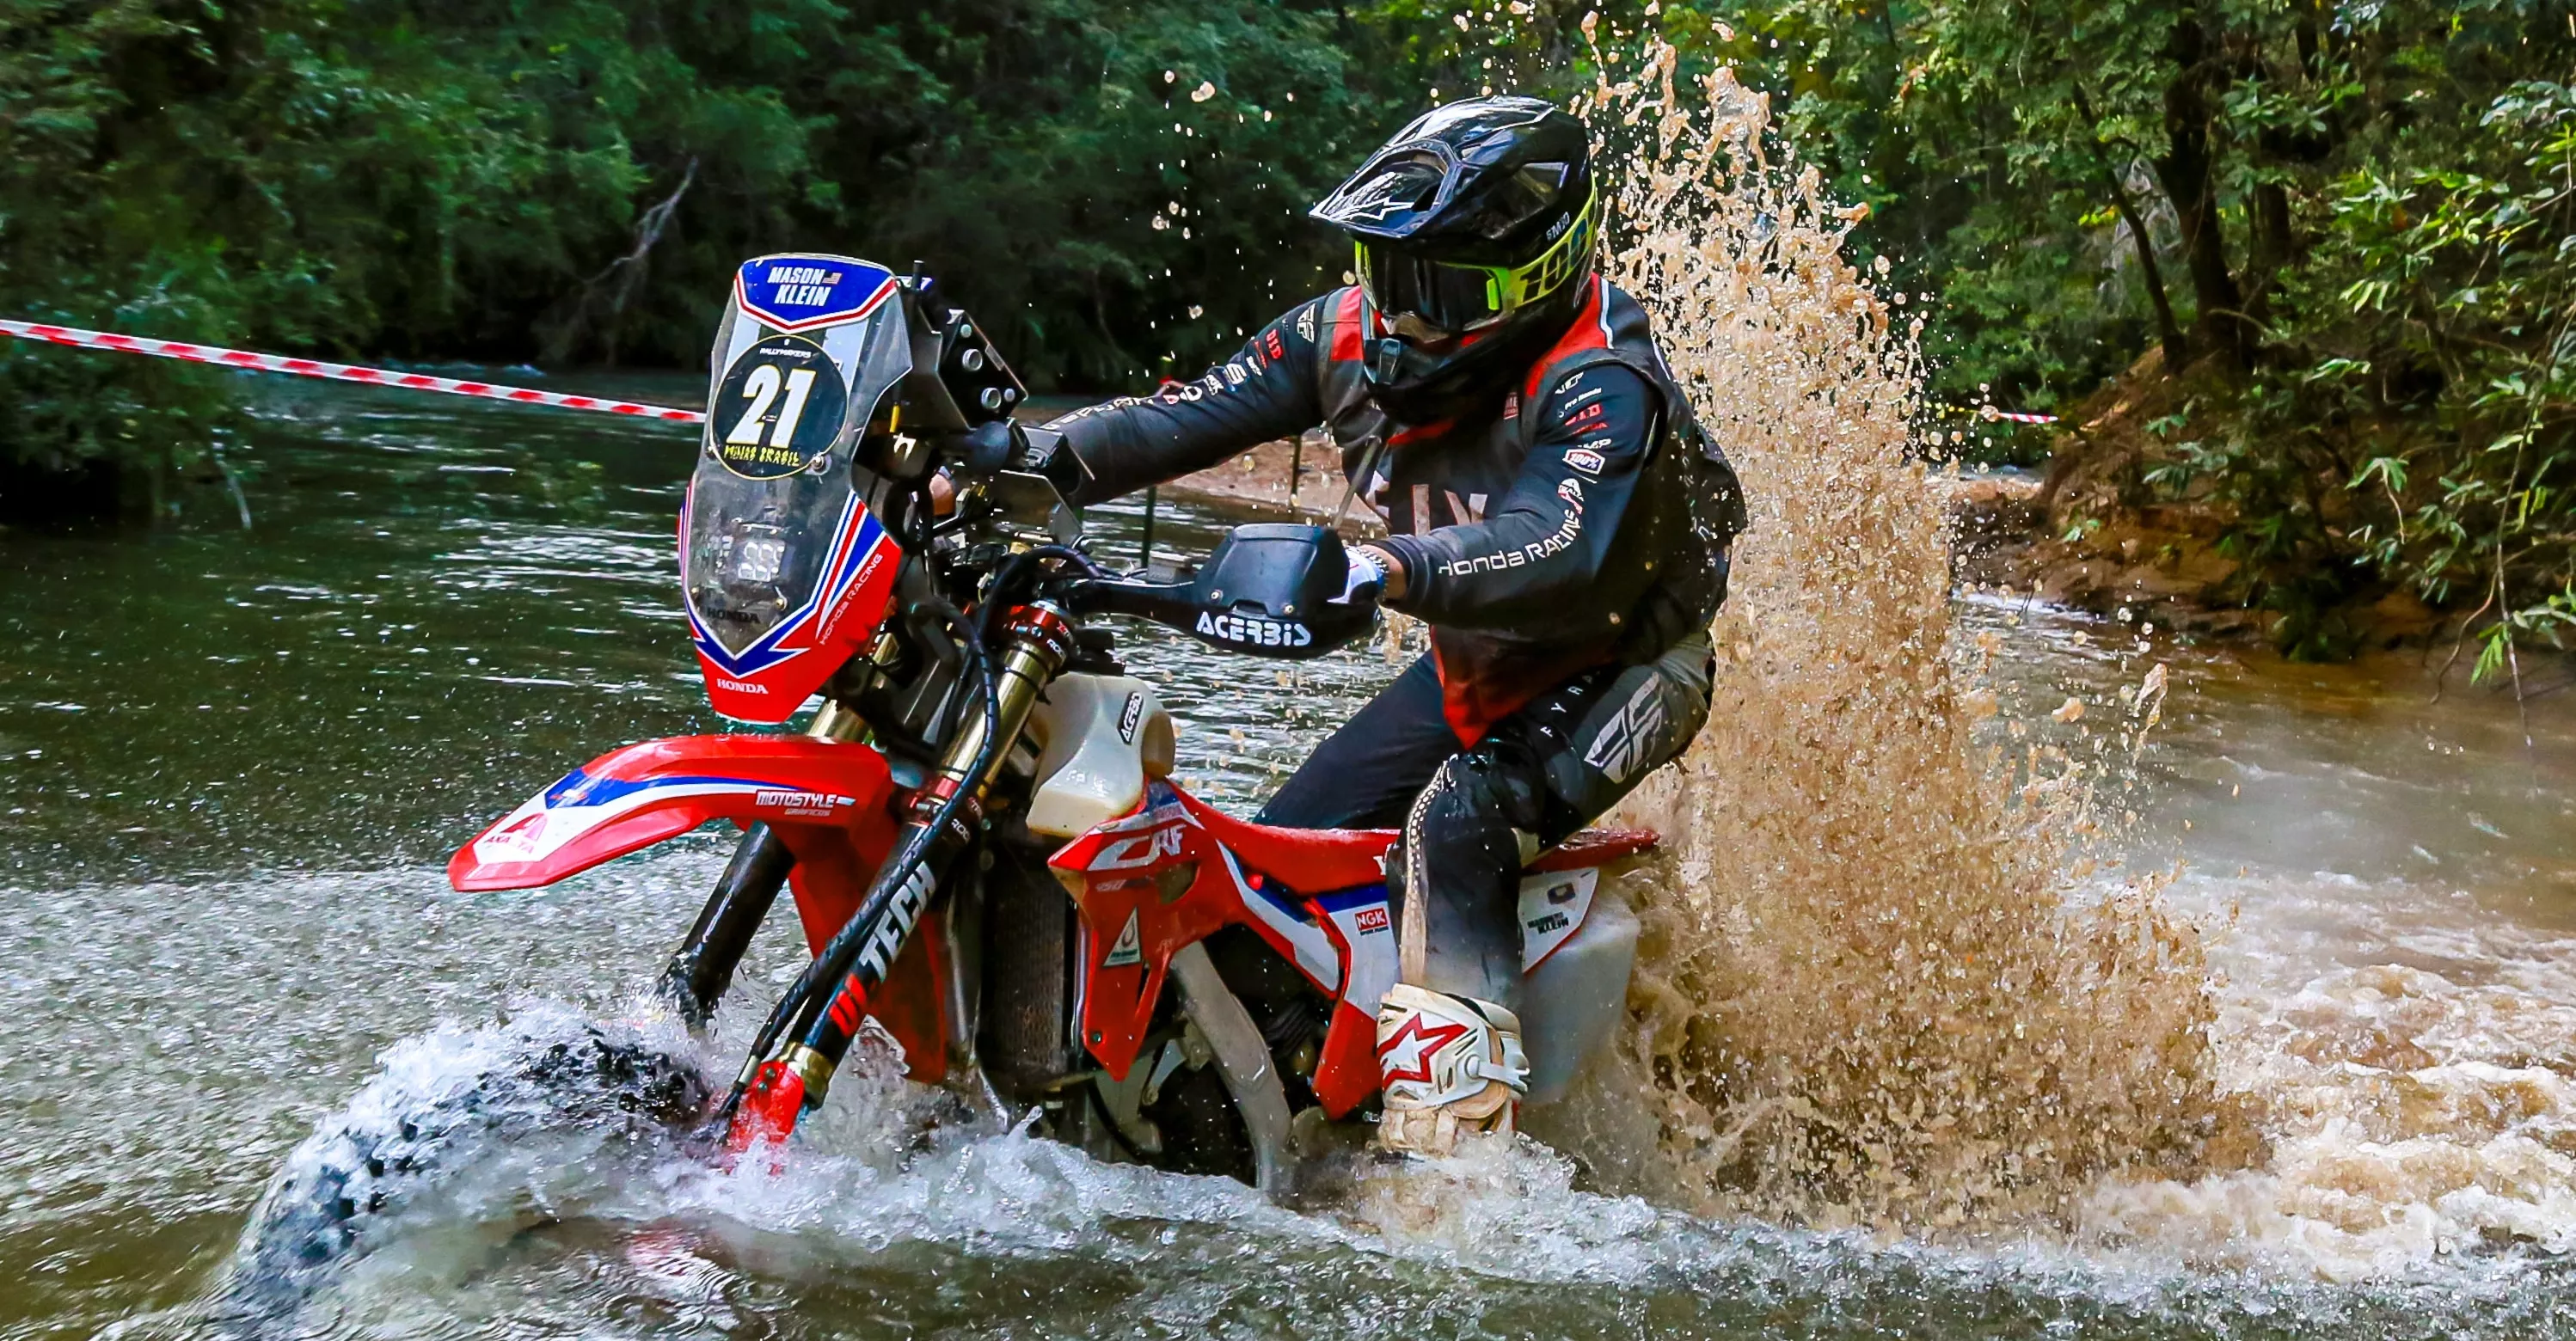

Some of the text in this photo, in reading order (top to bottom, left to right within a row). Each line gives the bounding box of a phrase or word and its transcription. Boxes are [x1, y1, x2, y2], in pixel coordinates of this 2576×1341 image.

[767, 266, 825, 285] MASON
[774, 284, 831, 307] KLEIN
[726, 364, 817, 449] 21
[1438, 509, 1581, 577] Honda RACING
[846, 553, 883, 600] RACING
[707, 608, 762, 624] HONDA
[1196, 610, 1312, 646] ACERBIS
[716, 678, 770, 695] HONDA
[756, 791, 837, 809] MOTOSTYLE
[1086, 824, 1187, 872] CRF
[860, 860, 937, 985] TECH
[1356, 910, 1386, 929] NGK
